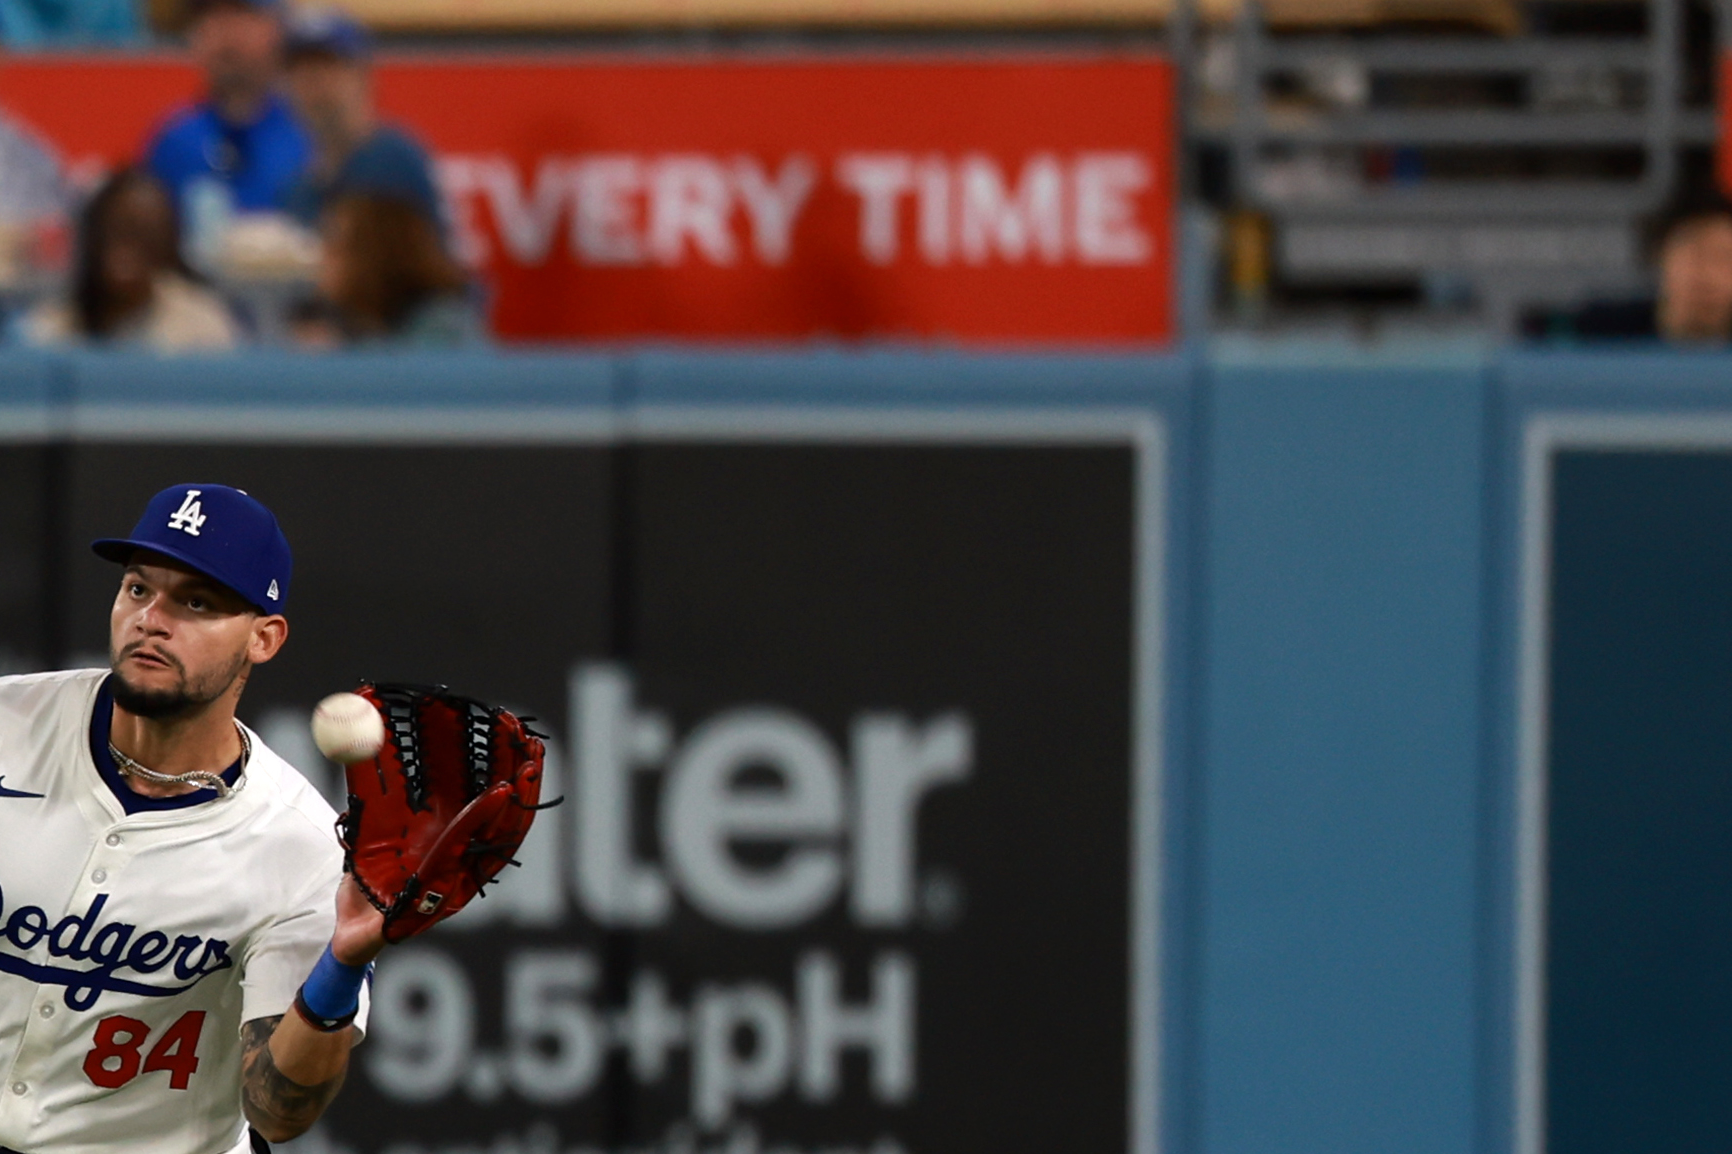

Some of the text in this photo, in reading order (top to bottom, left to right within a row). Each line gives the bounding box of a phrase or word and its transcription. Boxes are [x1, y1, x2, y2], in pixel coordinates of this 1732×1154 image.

[836, 152, 1153, 266] TIME
[167, 489, 207, 537] LA
[83, 1010, 207, 1090] 84
[368, 945, 918, 1128] 9.5+pH
